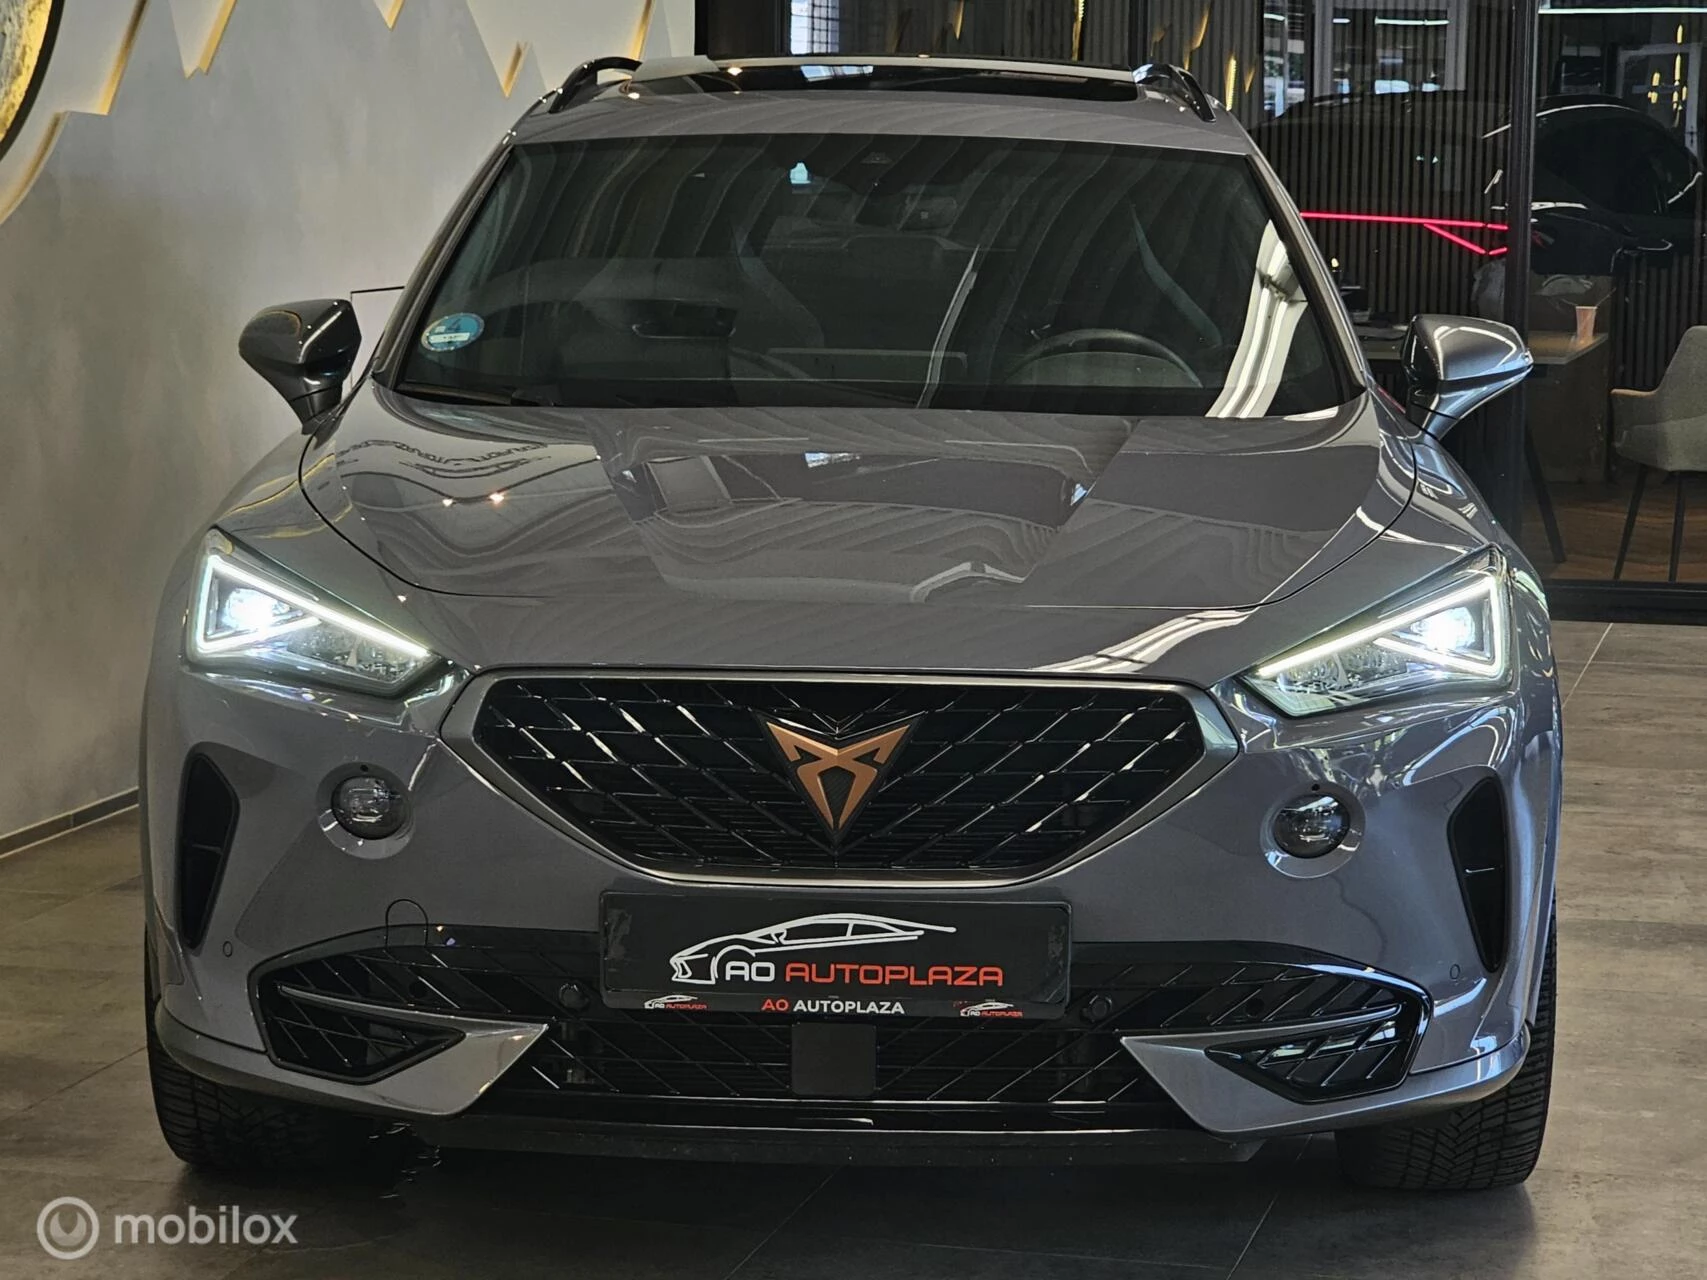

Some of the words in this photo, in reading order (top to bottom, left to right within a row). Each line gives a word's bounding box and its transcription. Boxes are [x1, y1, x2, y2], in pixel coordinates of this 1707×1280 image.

[724, 960, 776, 983] AO
[785, 962, 1004, 987] AUTOPLAZA
[761, 998, 789, 1012] AO
[793, 1000, 905, 1015] AUTOPLAZA
